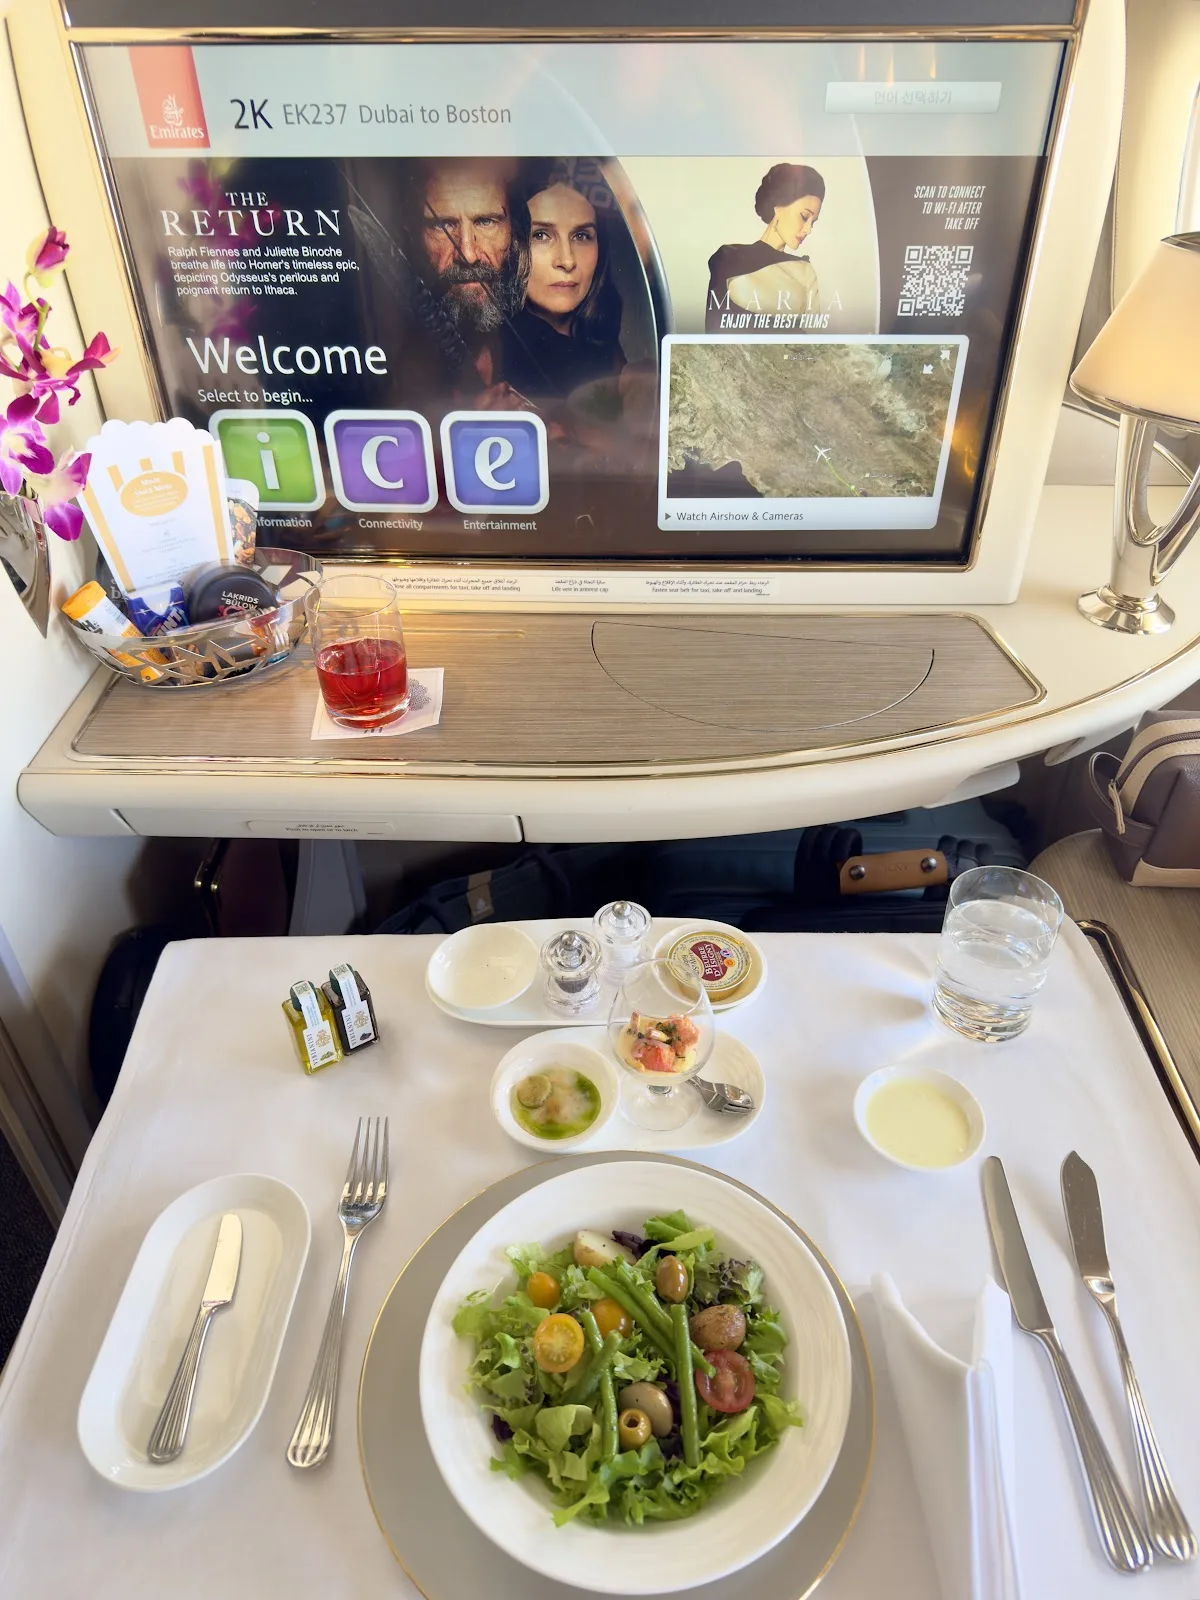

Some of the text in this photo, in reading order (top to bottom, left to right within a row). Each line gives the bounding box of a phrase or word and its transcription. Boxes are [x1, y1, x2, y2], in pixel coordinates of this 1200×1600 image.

[230, 98, 512, 130] 2K EK237 Dubai to Boston
[150, 124, 205, 140] Emirates
[226, 191, 268, 207] THE
[914, 186, 986, 198] SCAN TO CONNECT
[922, 201, 982, 214] TO WI-FI AFTER
[160, 209, 342, 237] RETURN
[944, 217, 980, 230] TAKE OFF
[168, 245, 342, 259] Ralph Fiennes and Juliette Binoche
[171, 259, 360, 273] breathe life into Homer's timeless epic,
[174, 271, 339, 284] depicting Odysseus's perilous and
[177, 284, 298, 297] poignant return to Ithaca.
[708, 290, 845, 311] MARIA
[720, 313, 829, 330] ENJOY THE BEST FILMS
[187, 335, 388, 375] Welcome
[198, 389, 313, 406] Select to begin...
[256, 431, 281, 490] i
[474, 436, 516, 491] e
[255, 517, 312, 528] nformation
[677, 511, 804, 521] Watch Airshow & Cameras
[358, 518, 423, 531] Connectivity
[463, 519, 537, 531] Entertainment
[222, 590, 260, 606] LAKRIDS
[698, 946, 714, 975] BEURRE
